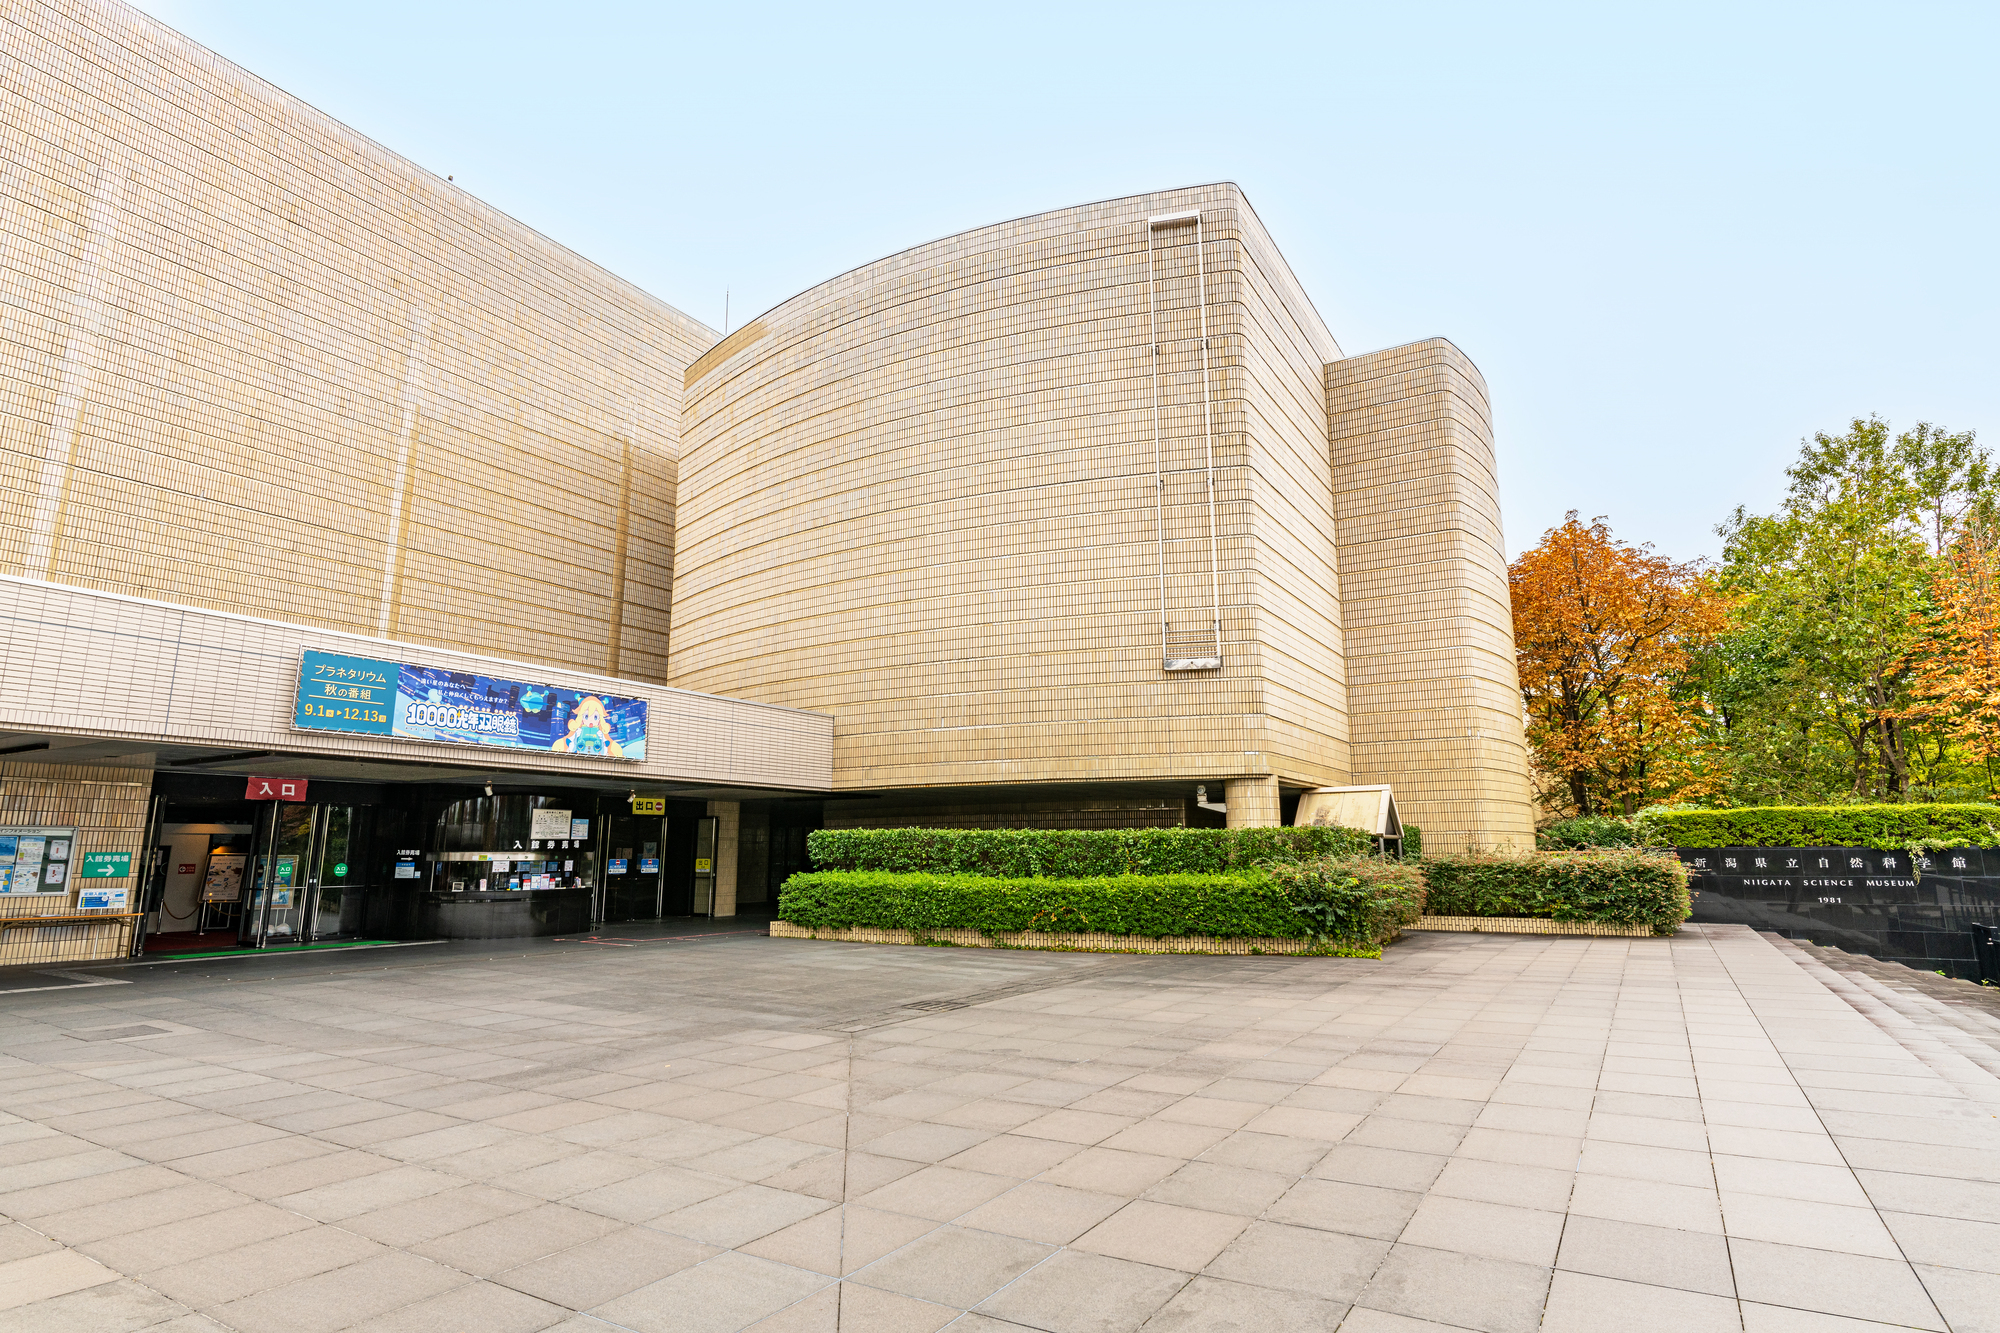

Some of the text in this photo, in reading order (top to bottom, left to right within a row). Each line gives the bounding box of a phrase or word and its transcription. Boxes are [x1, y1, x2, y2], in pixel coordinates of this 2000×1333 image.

[315, 664, 386, 683] プラネタリウム
[324, 684, 371, 700] 秋の番組
[406, 702, 518, 734] 10000光年双眼鏡
[259, 782, 296, 796] 入口
[636, 801, 653, 811] 出口
[513, 840, 580, 849] 入館券売場
[85, 855, 129, 863] 入館券売場
[1694, 857, 1967, 869] 新潟県立自然科学館
[1803, 879, 1854, 887] SCIENCE
